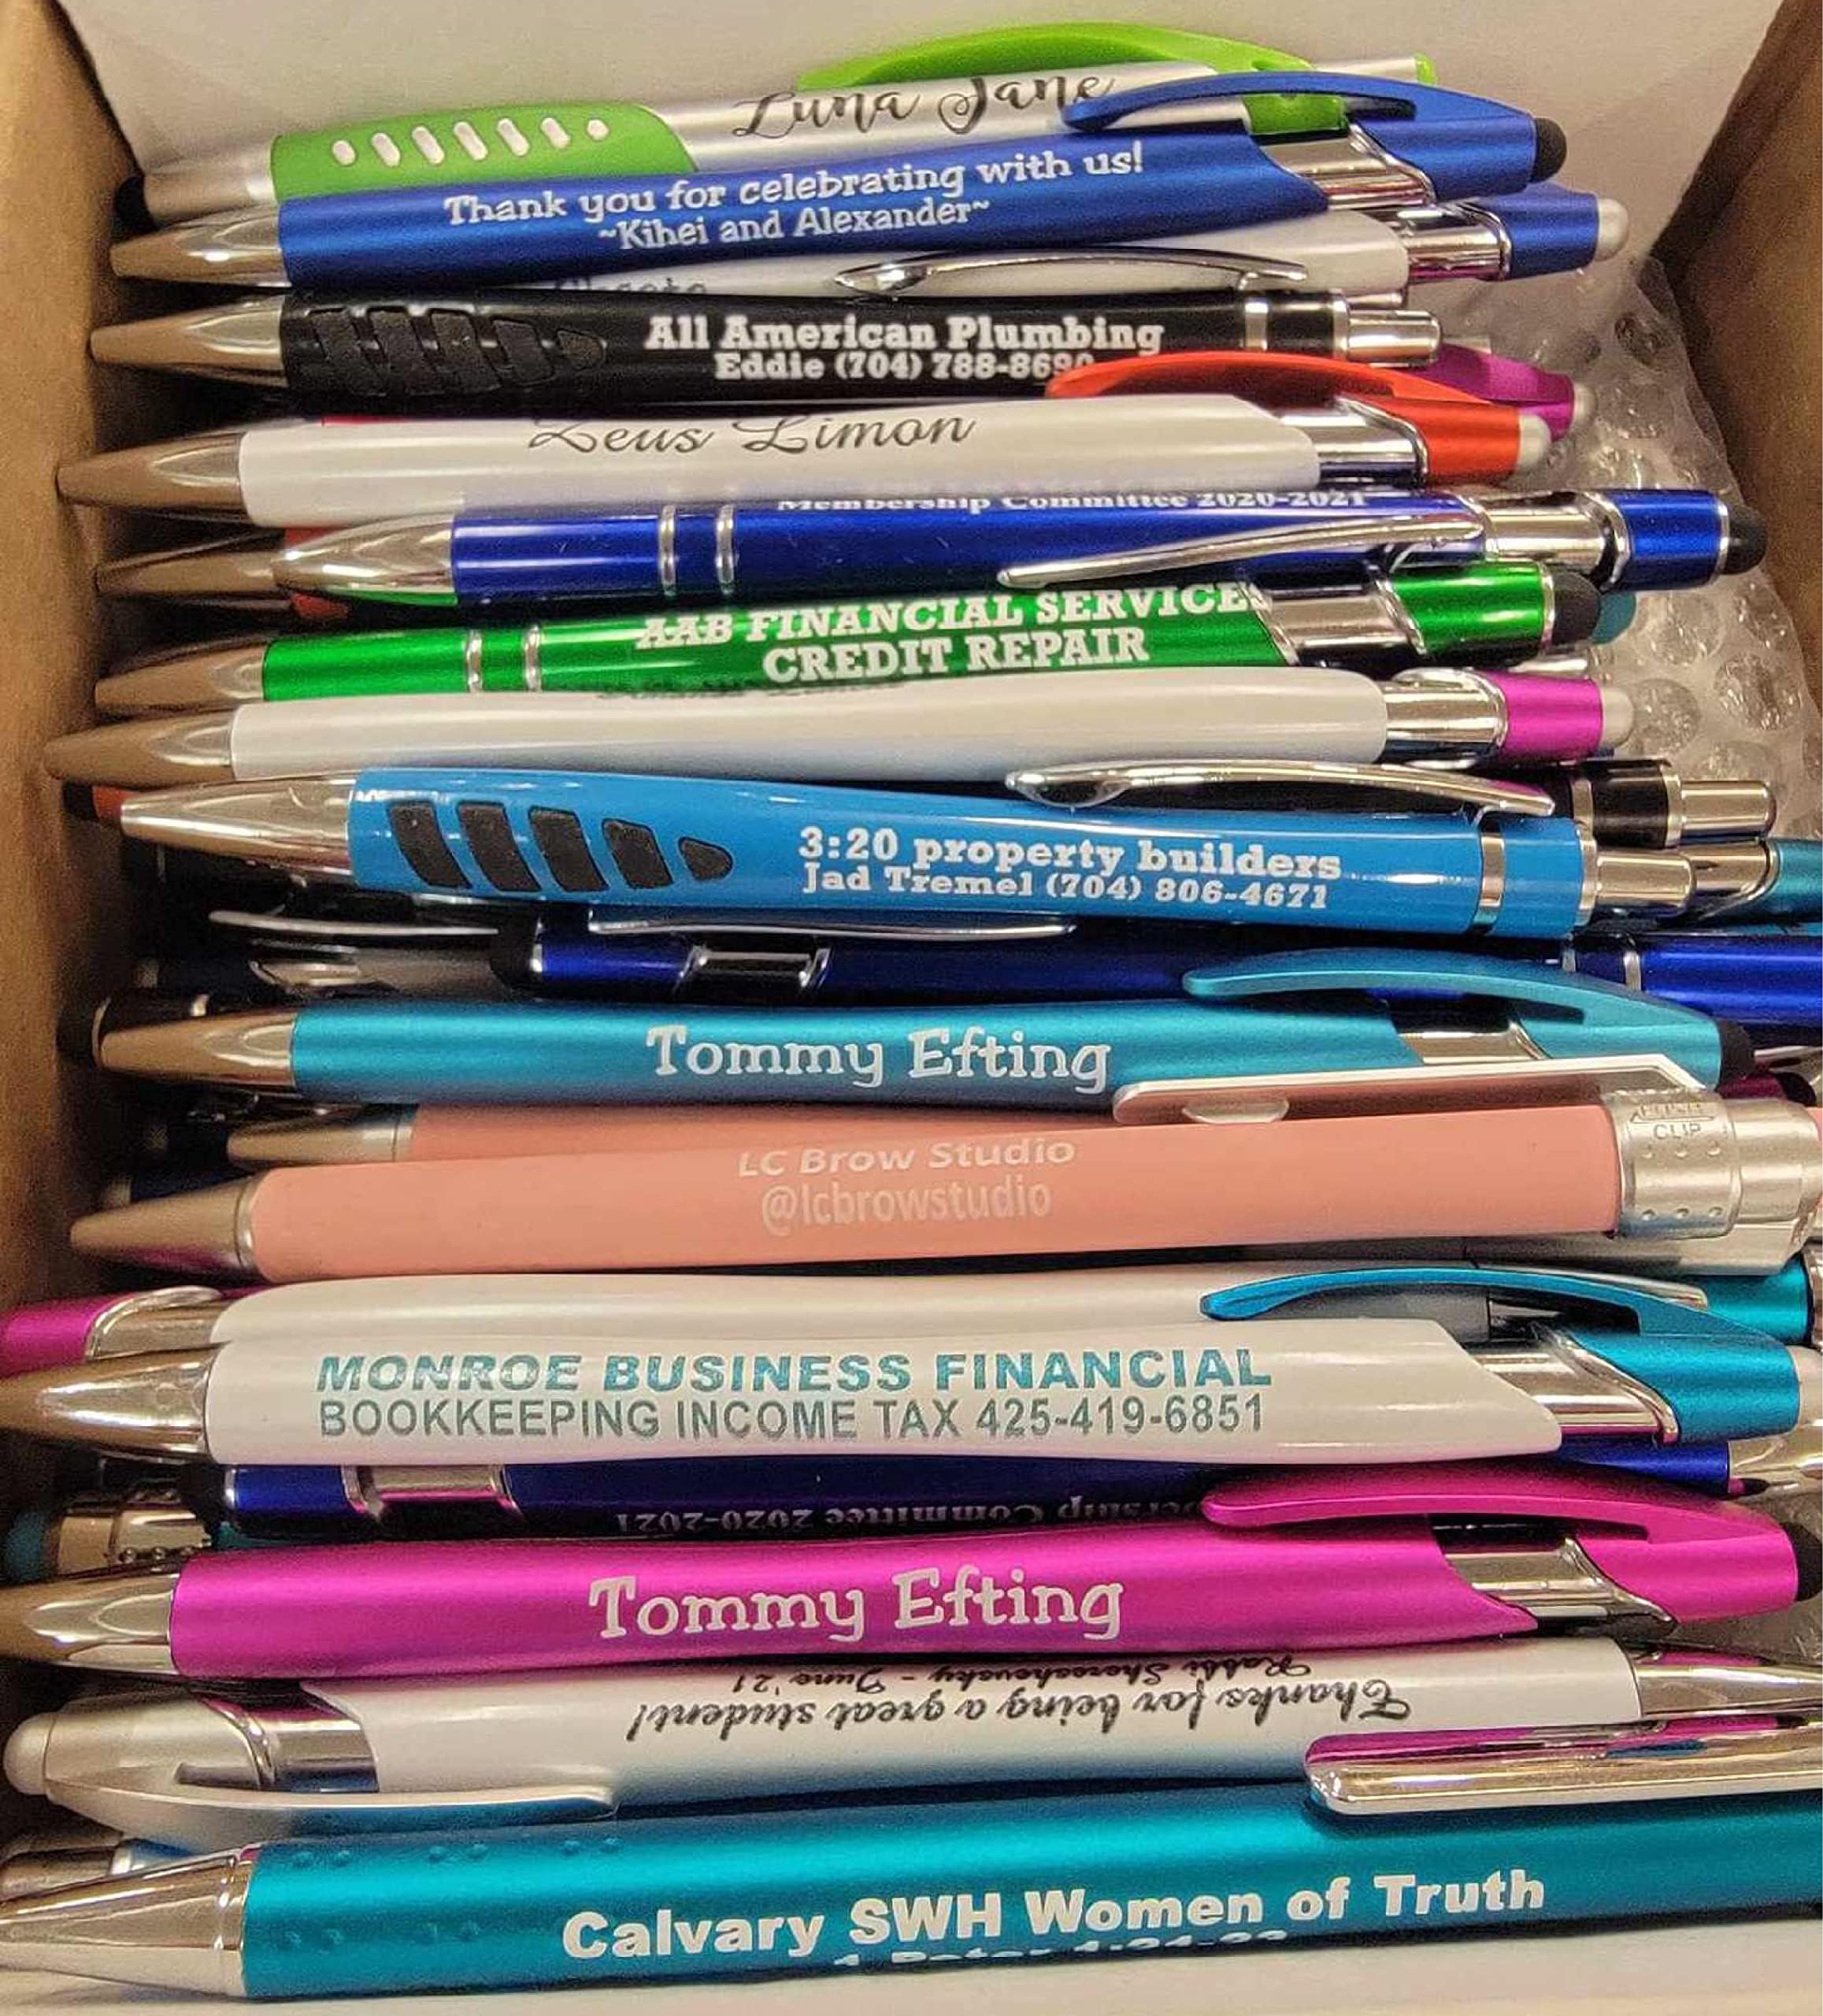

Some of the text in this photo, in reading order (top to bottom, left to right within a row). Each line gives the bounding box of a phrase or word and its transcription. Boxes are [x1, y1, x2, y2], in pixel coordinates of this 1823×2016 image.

[732, 74, 1115, 139] Luna Jane
[443, 140, 1143, 226] Thank you for celebrating with us!
[720, 210, 784, 243] and
[793, 198, 991, 235] Alexander~
[643, 315, 1165, 356] All American Plumbing
[715, 352, 824, 380] Eddie
[835, 352, 922, 381] (704)
[732, 413, 976, 454] Limon
[1195, 489, 1368, 508] 2020-2021
[636, 617, 732, 648] AAB
[744, 595, 1024, 642] FINANCIAL
[762, 625, 1150, 684] CREDIT REPAIR
[798, 827, 1340, 879] 3:20 property builders
[802, 864, 1328, 909] Jad Tremel (704) 806-4671
[646, 1024, 1111, 1095] Tommy Efting
[1654, 1122, 1701, 1140] CLIP
[738, 1137, 1076, 1177] LC Brow Studio
[761, 1176, 1052, 1236] @lcbrowstudio
[315, 1347, 1273, 1393] MONROE BUSINESS FINANCIAL
[319, 1392, 1267, 1440] BOOKKEEPING INCOME TAX 425-419-6851
[587, 1565, 1125, 1643] Tommy Efting
[788, 1666, 887, 1693] June
[1184, 1655, 1310, 1681] Rabbi
[624, 1679, 1411, 1742] Thanks for being a great student!
[561, 1910, 824, 1959] Calvary
[849, 1892, 1002, 1946] SWH
[1024, 1888, 1264, 1935] Women
[1287, 1877, 1348, 1922] of
[1374, 1870, 1546, 1916] Truth
